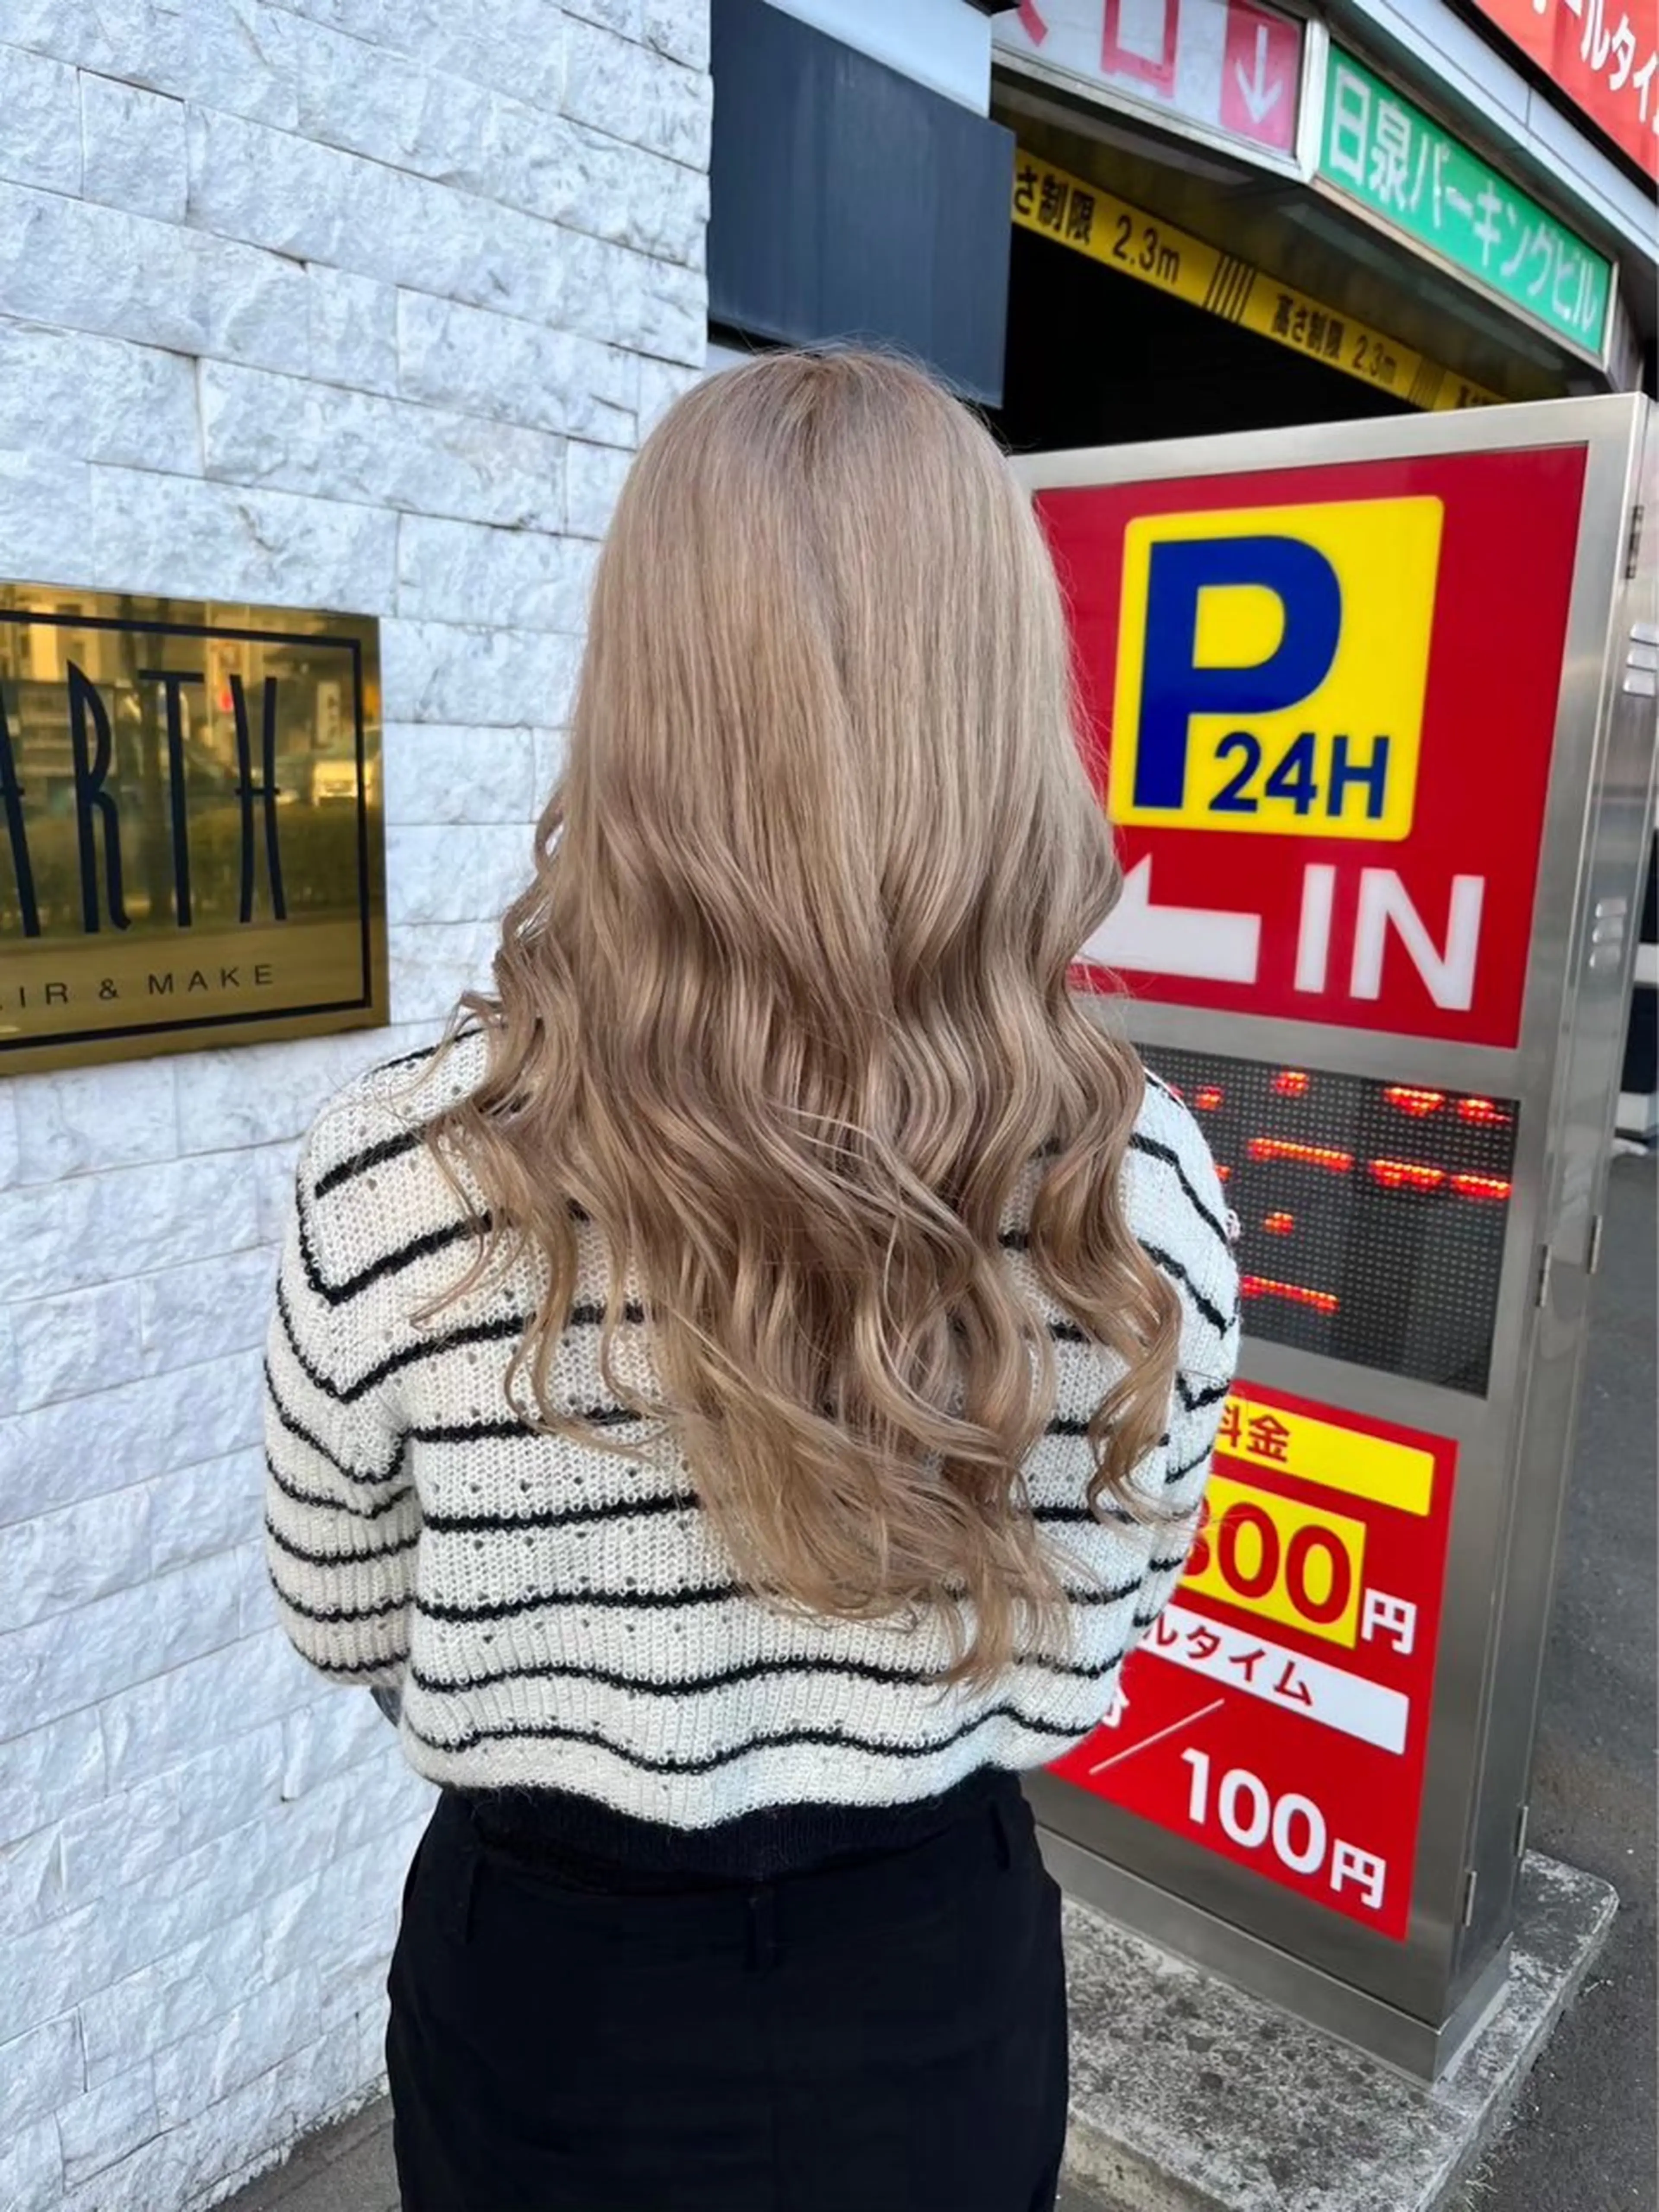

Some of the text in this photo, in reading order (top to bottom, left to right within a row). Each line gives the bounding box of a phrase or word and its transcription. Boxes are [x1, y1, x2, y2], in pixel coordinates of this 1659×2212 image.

[1017, 0, 1180, 99] 口
[1111, 214, 1181, 285] 2.3m
[1133, 535, 1342, 809] P
[1208, 731, 1390, 820] 24H
[99, 978, 118, 1000] &
[148, 964, 274, 995] MAKE
[1294, 863, 1485, 1011] IN
[1181, 1747, 1386, 1910] 100円
